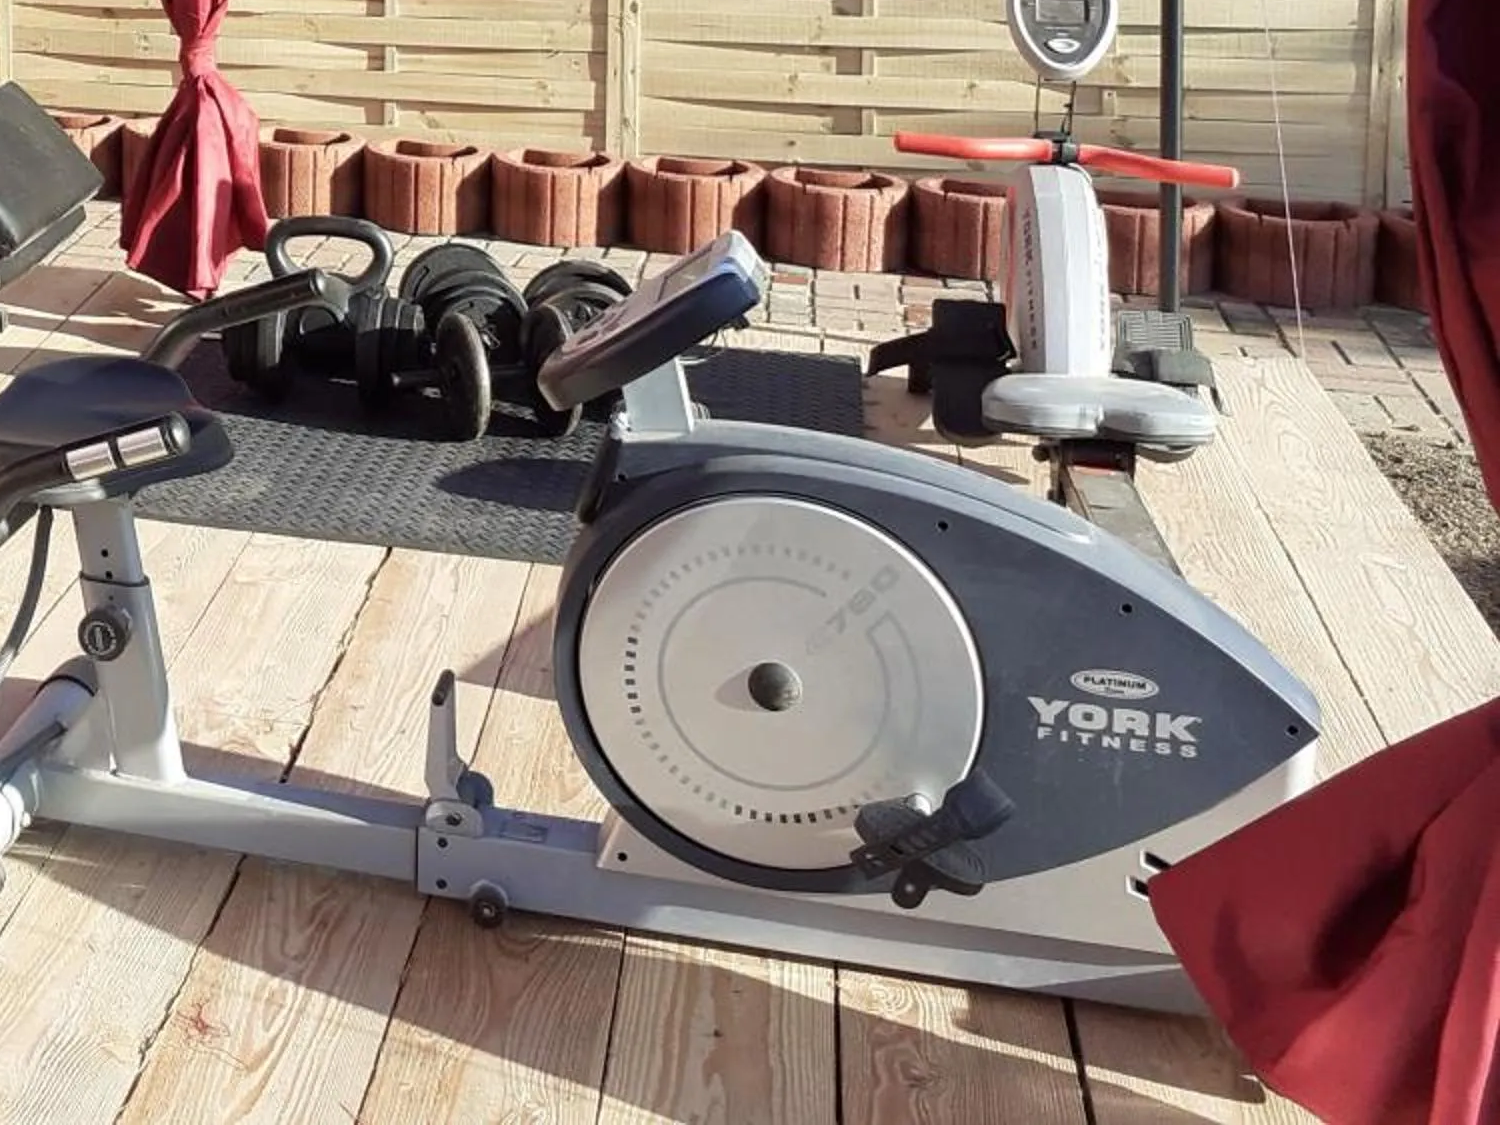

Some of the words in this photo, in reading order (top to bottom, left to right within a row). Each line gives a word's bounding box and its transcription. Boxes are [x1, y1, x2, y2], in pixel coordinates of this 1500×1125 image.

[1083, 675, 1147, 690] PLATINUM
[1026, 696, 1201, 742] YORK
[1036, 726, 1197, 759] FITNESS
